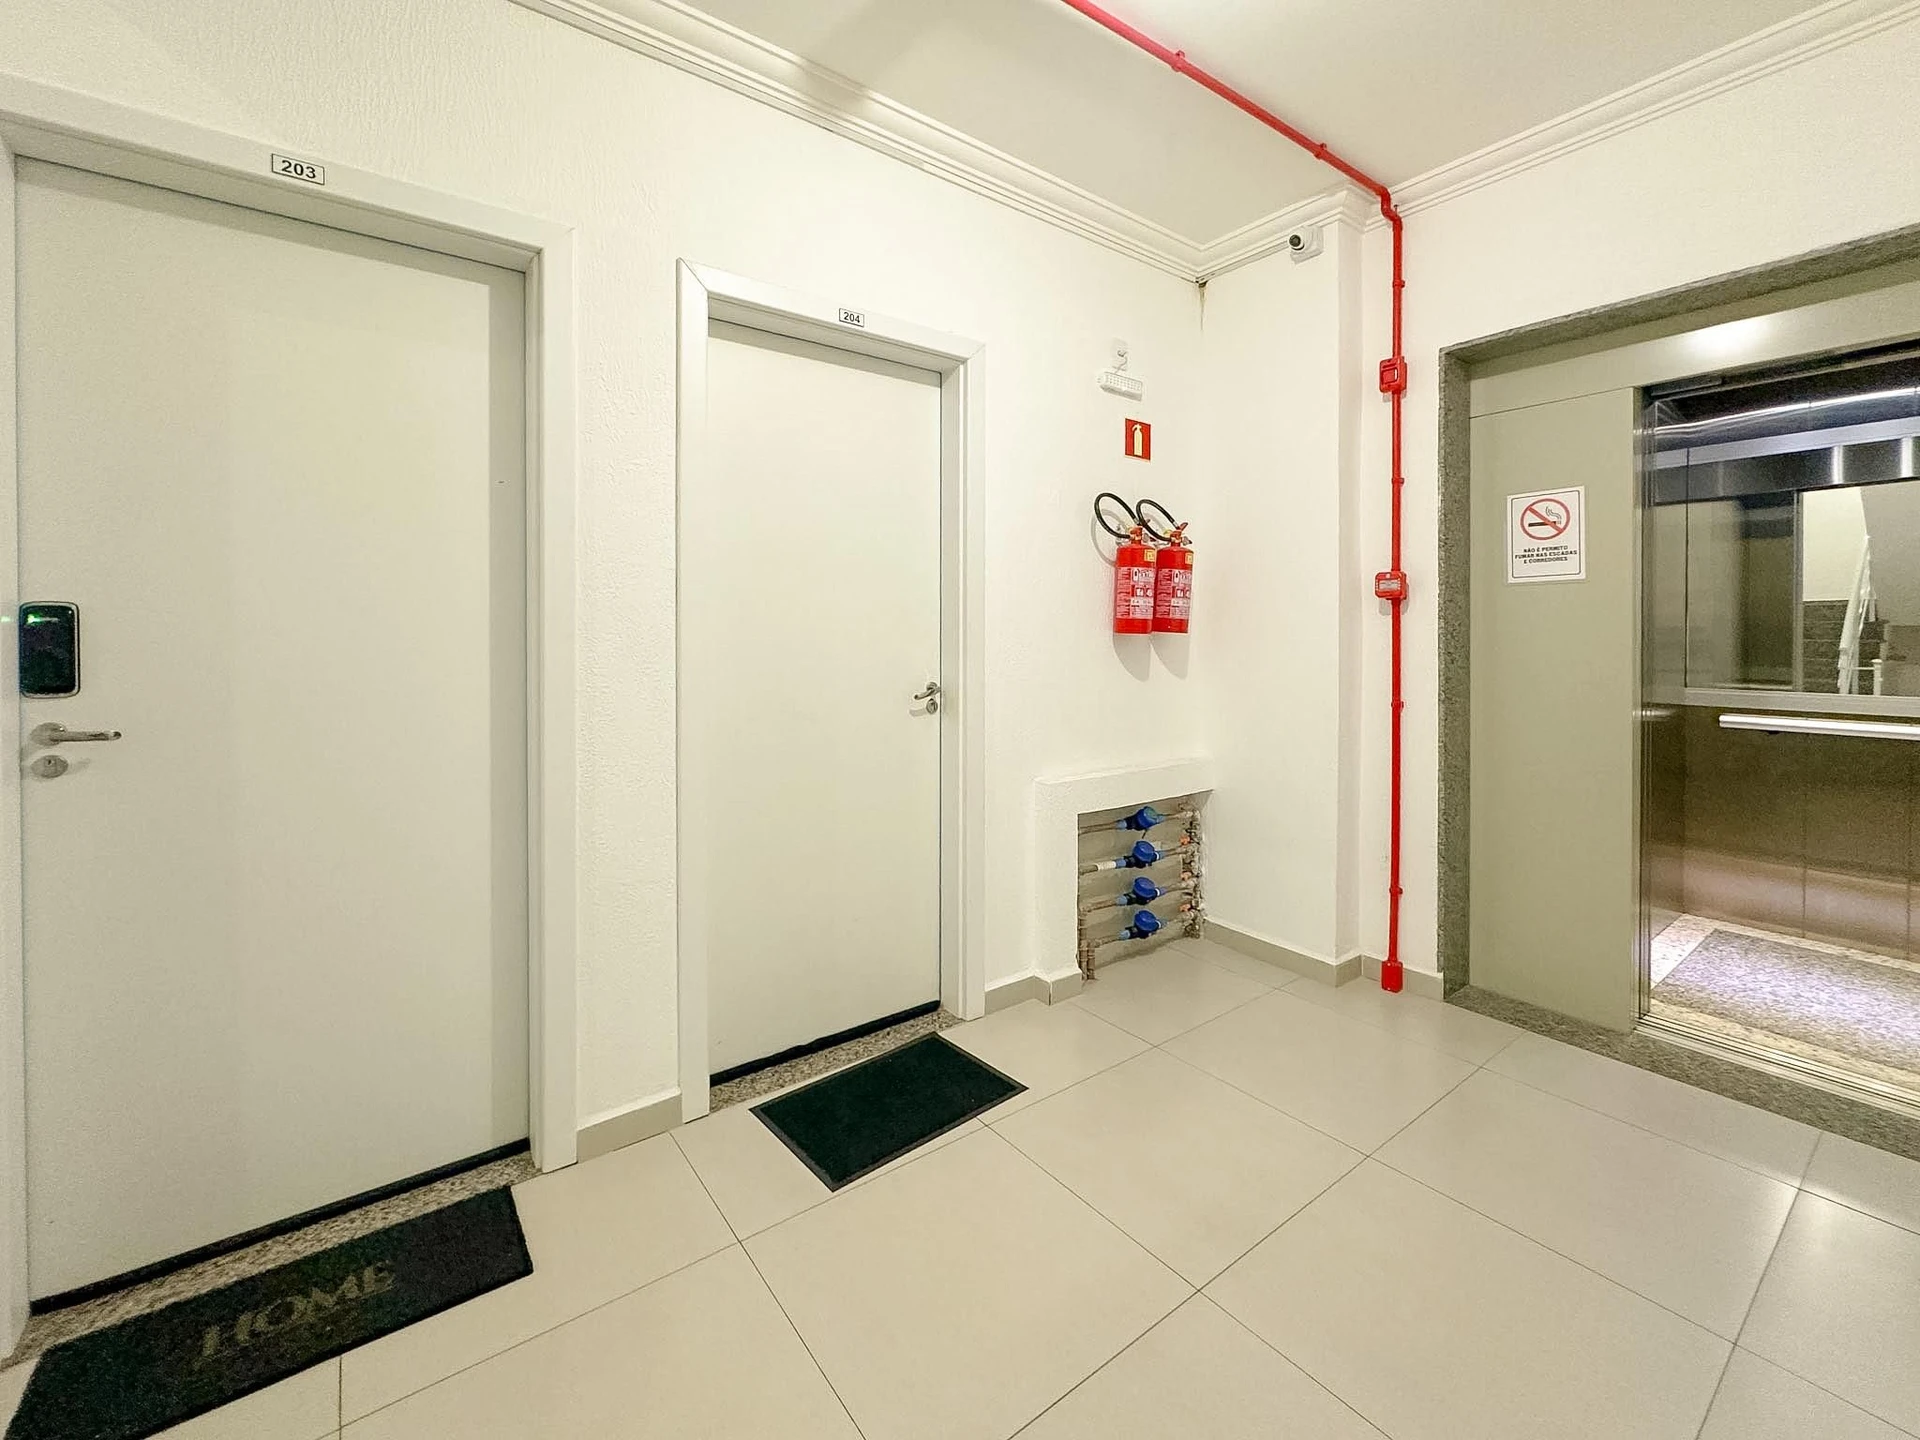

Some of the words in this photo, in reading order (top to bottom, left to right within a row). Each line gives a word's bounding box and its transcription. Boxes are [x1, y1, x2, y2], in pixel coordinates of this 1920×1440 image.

[281, 160, 316, 179] 203
[843, 311, 861, 323] 204
[1528, 556, 1568, 564] CORREDORES
[196, 1259, 396, 1366] HOME
